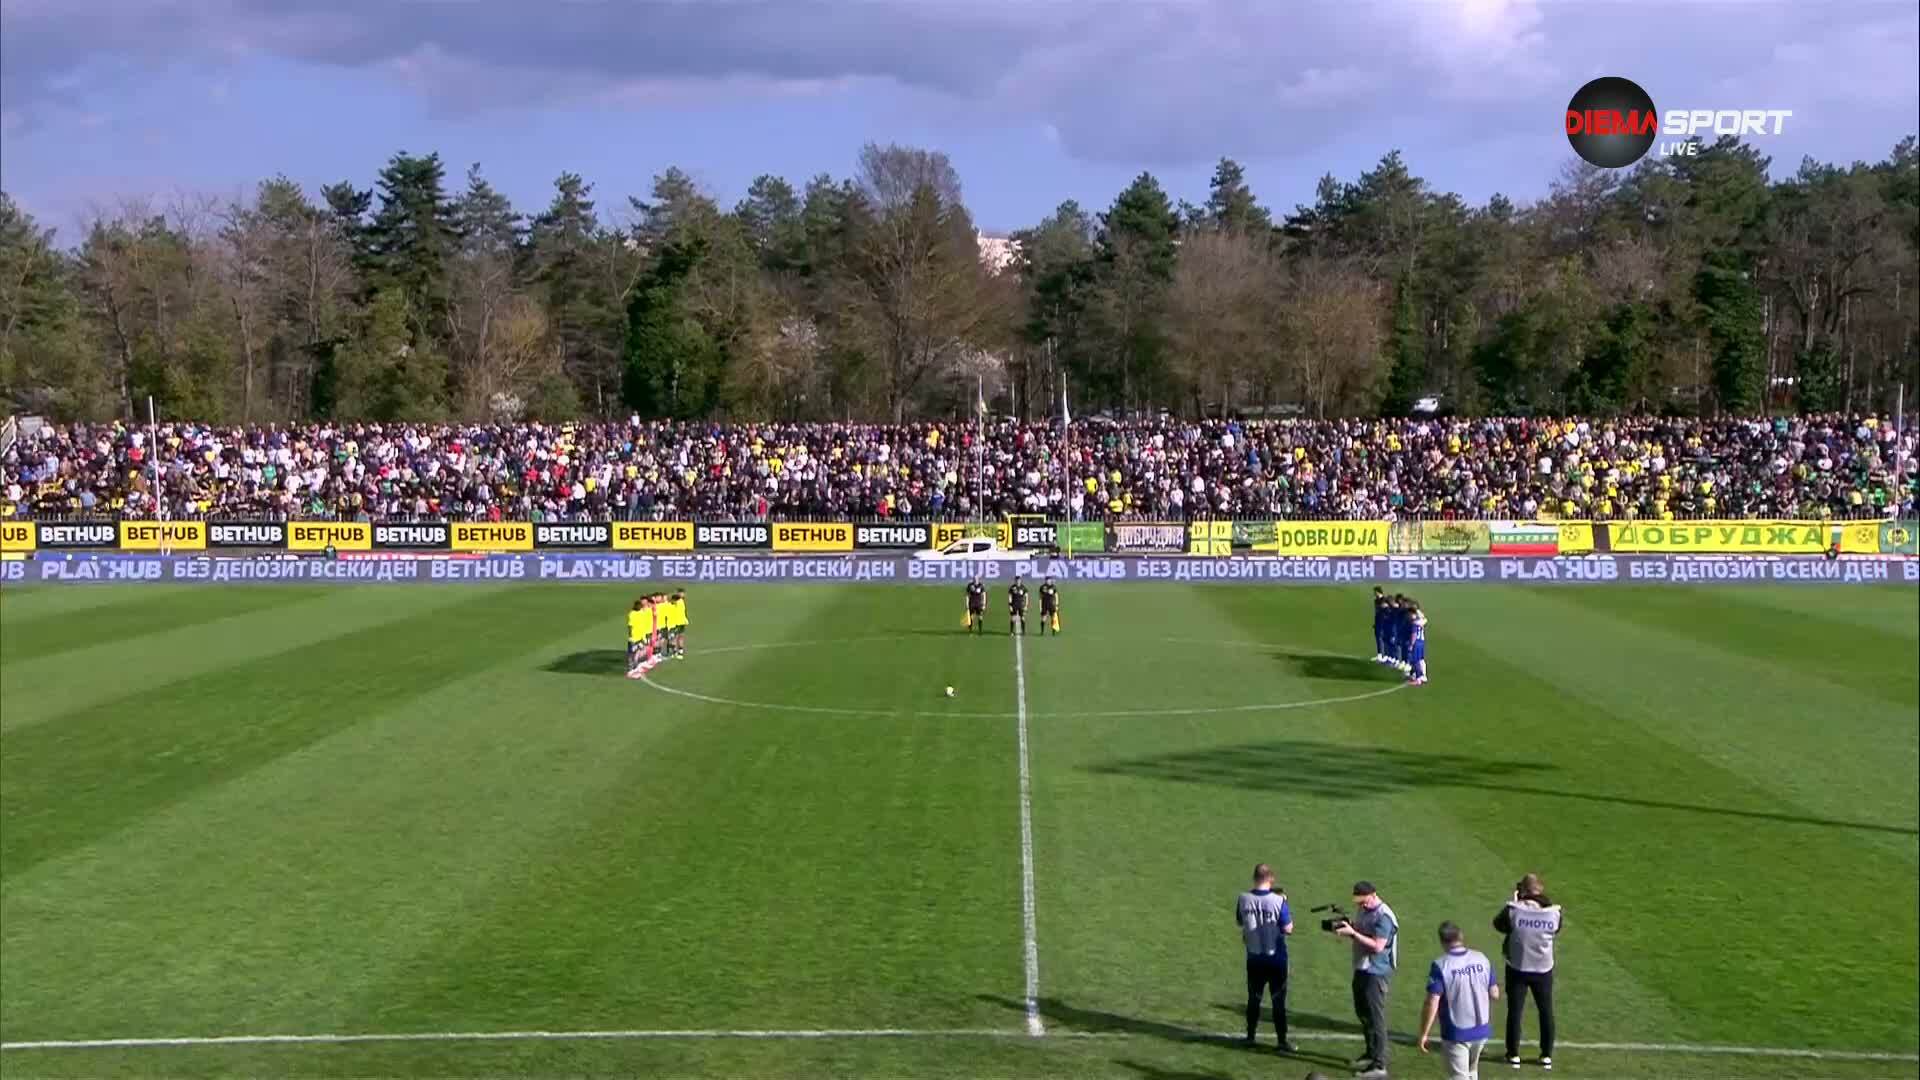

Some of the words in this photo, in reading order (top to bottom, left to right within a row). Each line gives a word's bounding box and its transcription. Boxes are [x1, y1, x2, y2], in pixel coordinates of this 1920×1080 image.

[40, 525, 115, 542] BETHUB
[127, 527, 199, 541] BETHUB
[211, 525, 283, 542] BETHUB
[294, 527, 365, 541] BETHUB
[376, 525, 447, 543] BETHUB
[457, 527, 526, 541] BETHUB
[537, 525, 608, 542] BETHUB
[619, 527, 687, 541] BETHUB
[698, 525, 768, 543] BETHUB
[778, 528, 847, 542] BETHUB
[857, 527, 927, 543] BETHUB
[1281, 528, 1378, 548] DOBRUDJA
[1616, 526, 1823, 546] ДОБРУДЖА
[173, 560, 210, 579] БЕЗ
[213, 560, 308, 581] ДЕПОЗИТ
[310, 560, 374, 579] ВСЕКИ
[376, 560, 417, 581] ДЕН
[431, 560, 526, 579] BETHUB
[662, 560, 697, 579] БЕЗ
[699, 560, 789, 581] ДЕПОЗИТ
[792, 560, 852, 579] ВСЕКИ
[856, 560, 896, 581] ДЕН
[908, 560, 1001, 579] BETHUB
[1137, 560, 1172, 579] БЕЗ
[1175, 560, 1269, 581] ДЕПОЗИТ
[1271, 560, 1332, 579] ВСЕКИ
[1334, 560, 1376, 581] ДЕН
[1388, 560, 1485, 579] BETHUB
[1630, 560, 1667, 579] БЕЗ
[1671, 560, 1769, 581] ДЕПОЗИТ
[1772, 560, 1841, 579] ВСЕКИ
[1844, 560, 1888, 581] ДЕН
[1517, 918, 1555, 930] PHOTO
[1451, 963, 1484, 976] PHOTO
